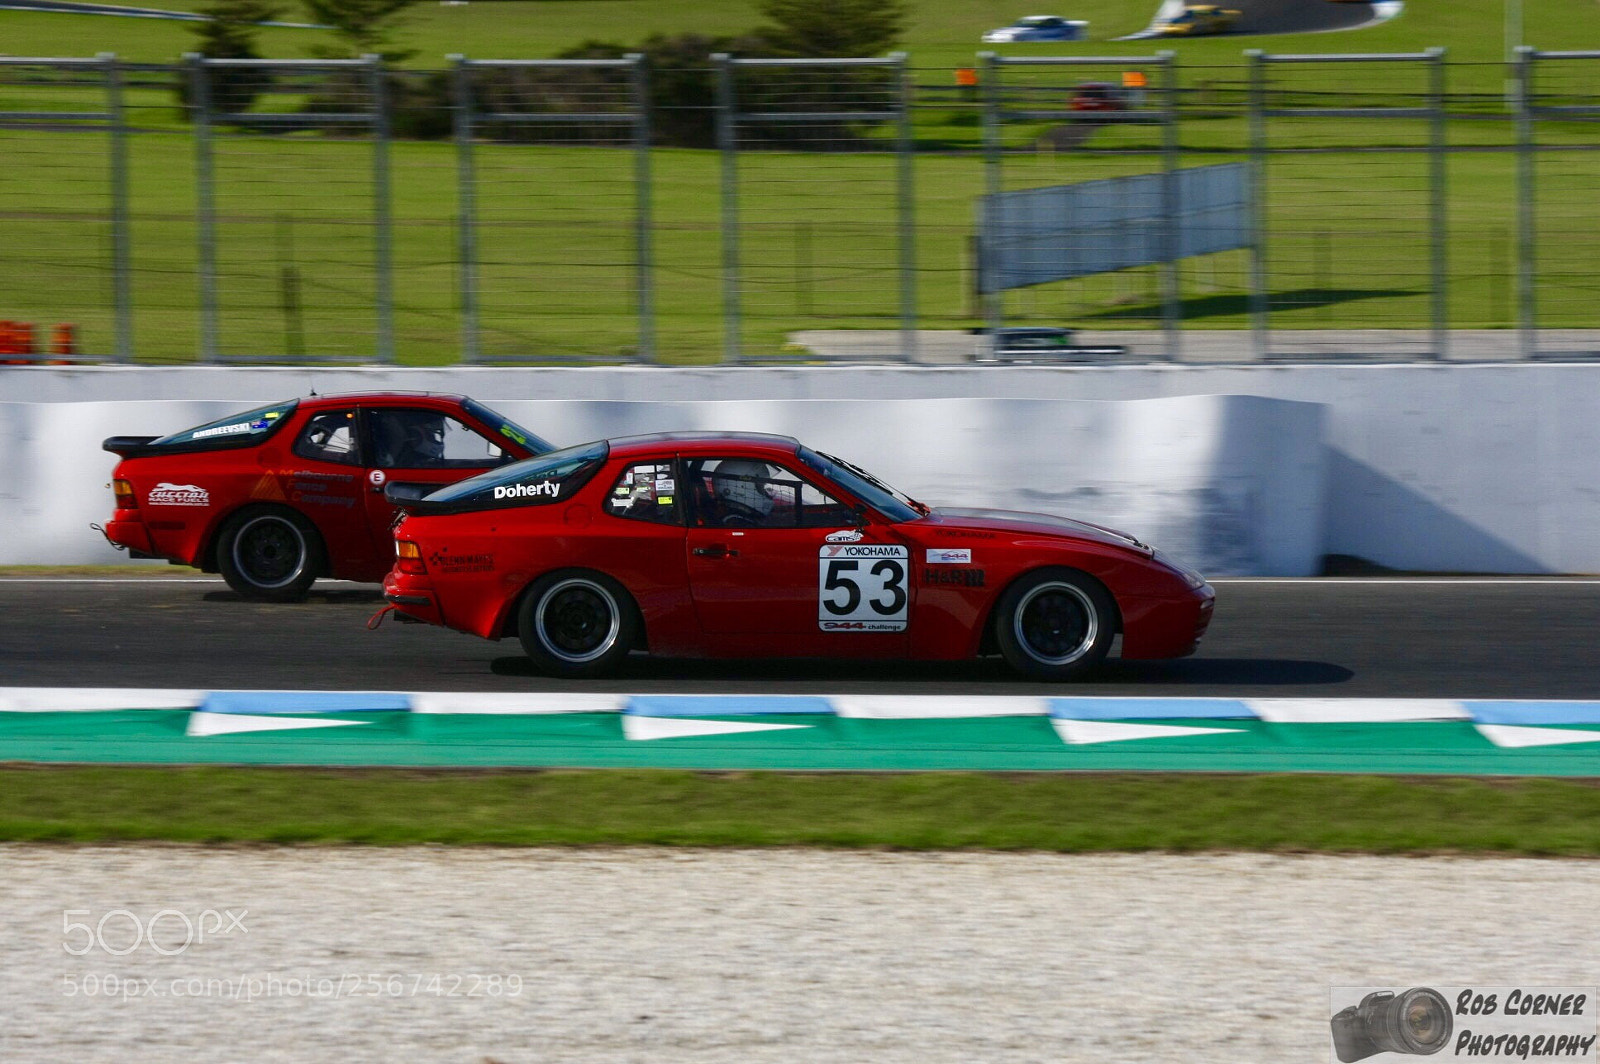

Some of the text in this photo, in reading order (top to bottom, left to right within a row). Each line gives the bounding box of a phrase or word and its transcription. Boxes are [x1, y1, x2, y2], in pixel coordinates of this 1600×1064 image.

[373, 473, 381, 482] E
[494, 481, 560, 499] Doherty
[844, 547, 900, 557] YOKOHAMA
[823, 560, 906, 615] 53
[823, 622, 867, 630] 944
